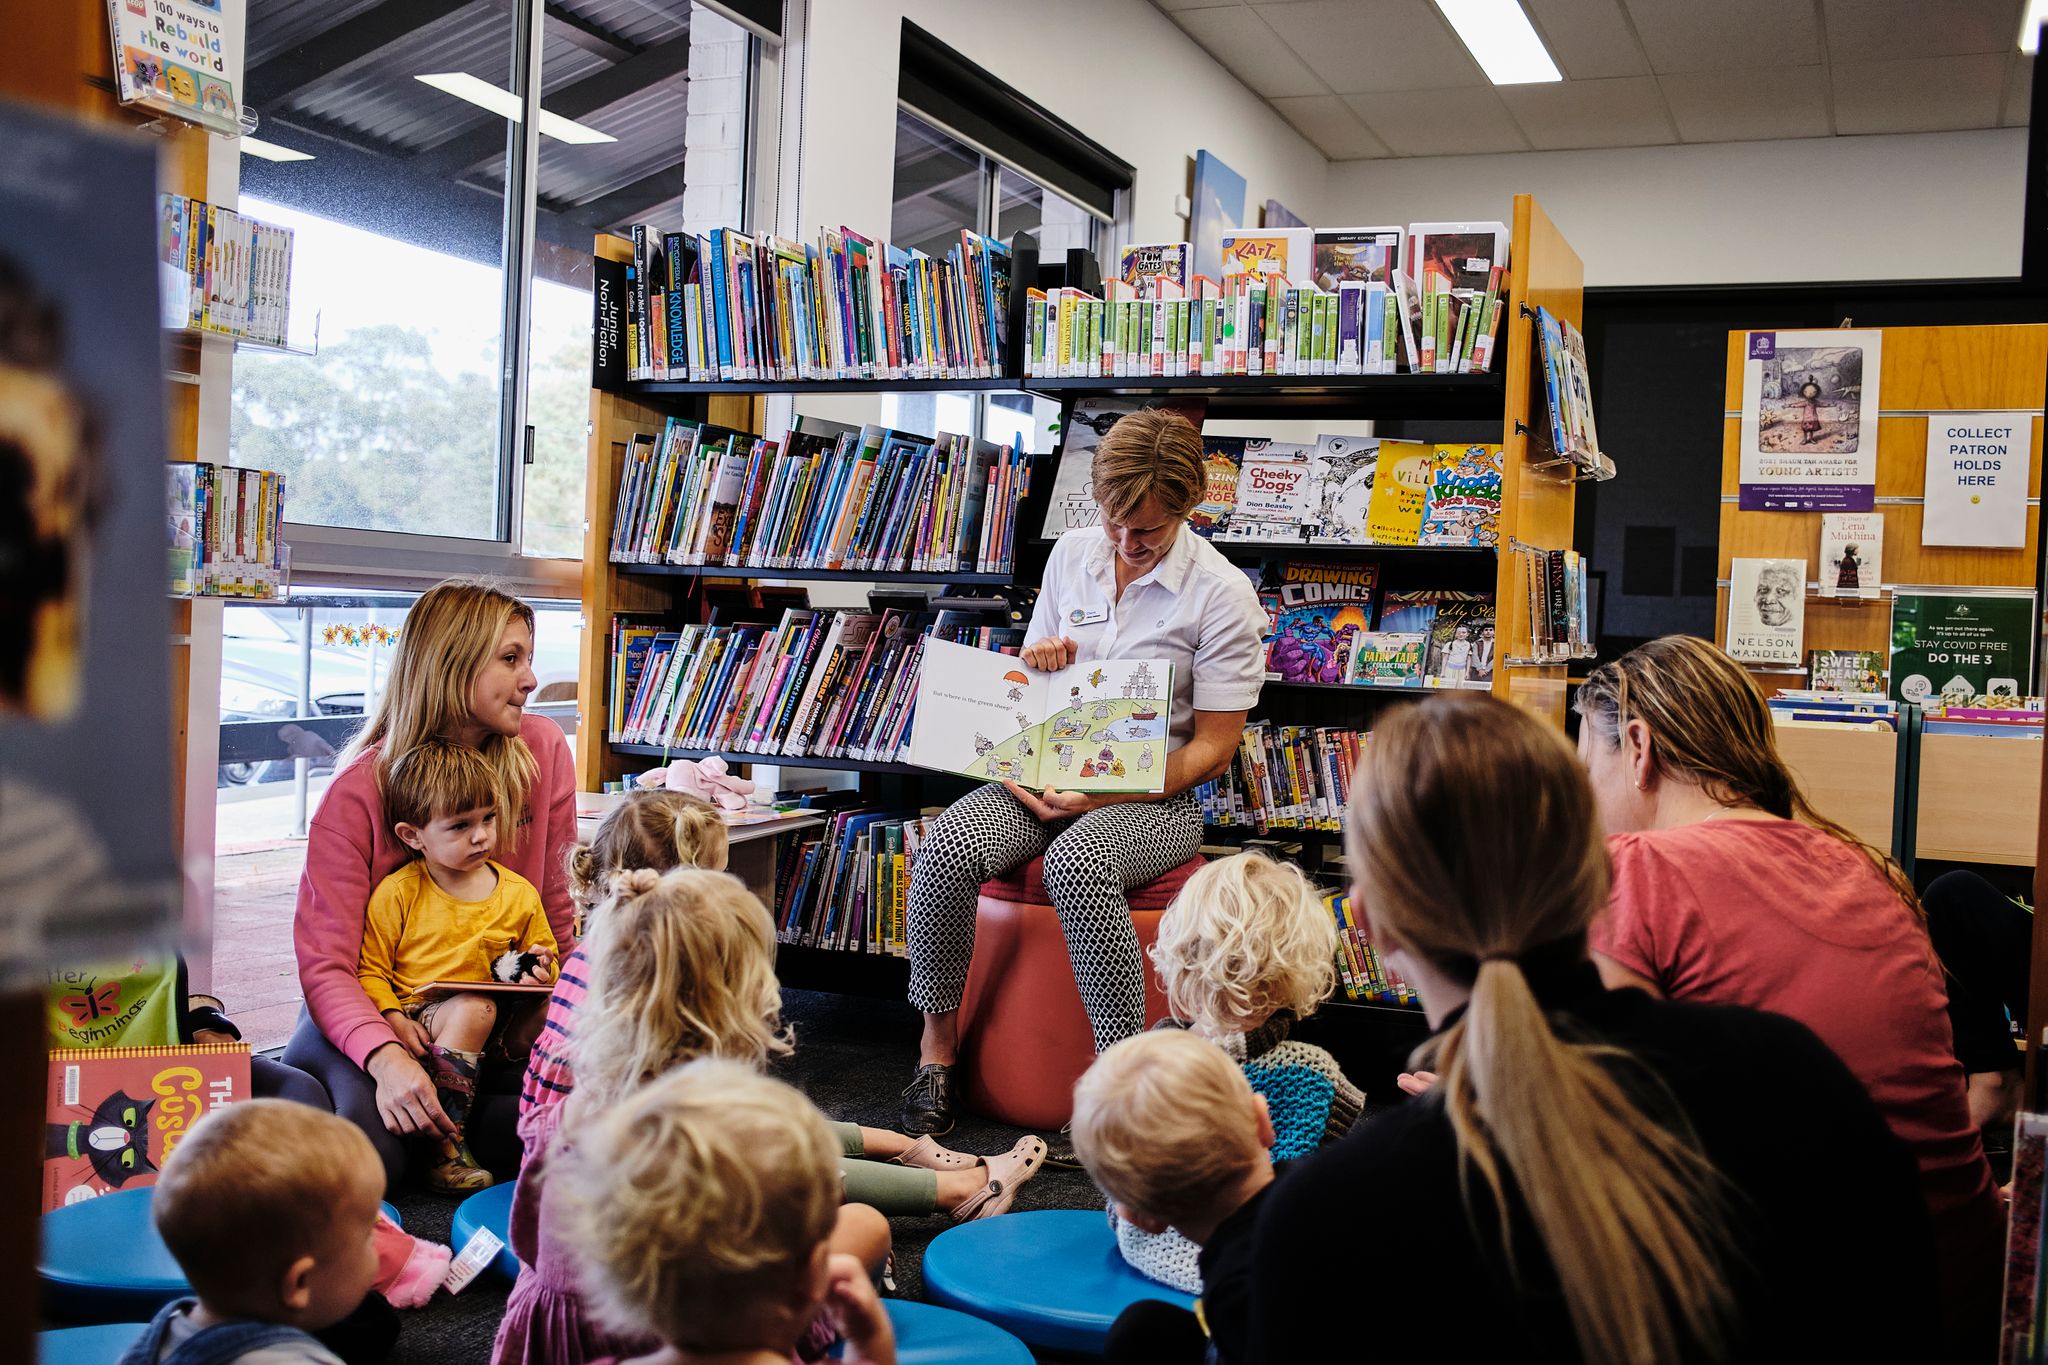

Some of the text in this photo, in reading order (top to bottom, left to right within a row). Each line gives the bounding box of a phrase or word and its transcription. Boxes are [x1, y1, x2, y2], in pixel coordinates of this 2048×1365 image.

[154, 0, 218, 33] 100 ways to
[155, 16, 221, 52] Rebuild
[140, 31, 223, 72] the world
[673, 237, 681, 280] ENCYCLOPEDIA
[1141, 252, 1162, 261] TOM
[1236, 242, 1276, 260] KATT
[1138, 261, 1162, 270] GATES
[600, 279, 609, 367] Non-Fiction
[610, 301, 618, 349] Junior
[670, 292, 683, 363] KNOWLEDGE
[903, 303, 911, 336] NGANGA
[1948, 428, 2012, 438] COLLECT
[1950, 445, 2007, 455] PATRON
[1758, 467, 1858, 476] YOUNG ARTISTS
[1954, 460, 2001, 470] HOLDS
[870, 465, 880, 486] BEARS
[1250, 468, 1302, 483] Cheeky
[1436, 469, 1501, 486] Knock
[1958, 476, 1996, 486] HERE
[1253, 478, 1294, 493] Dogs
[1433, 485, 1501, 500] Knock
[859, 493, 872, 519] PANDAS
[1265, 502, 1293, 511] Beasley
[1842, 522, 1865, 531] Lena
[1831, 532, 1876, 541] Mukhina
[1286, 567, 1372, 585] DRAWING
[1280, 583, 1370, 606] COMICS
[1737, 638, 1794, 647] NELSON
[1914, 640, 2008, 651] STAY COVID FREE
[1732, 649, 1798, 658] MANDELA
[1928, 653, 1992, 664] DO THE 3
[1820, 656, 1870, 668] SWEET
[780, 628, 821, 726] Children's BOOK music
[816, 649, 840, 701] STAR WARS
[1821, 669, 1869, 680] DREAMS
[803, 679, 819, 707] COMPLETE
[944, 693, 961, 701] where
[977, 700, 993, 708] green
[994, 702, 1013, 711] sheep?
[2031, 703, 2039, 711] H
[806, 702, 821, 735] CHARACTER
[1246, 773, 1255, 790] CAMP
[904, 840, 912, 856] WHAT
[896, 899, 903, 907] DO
[895, 908, 903, 942] ANYTHING
